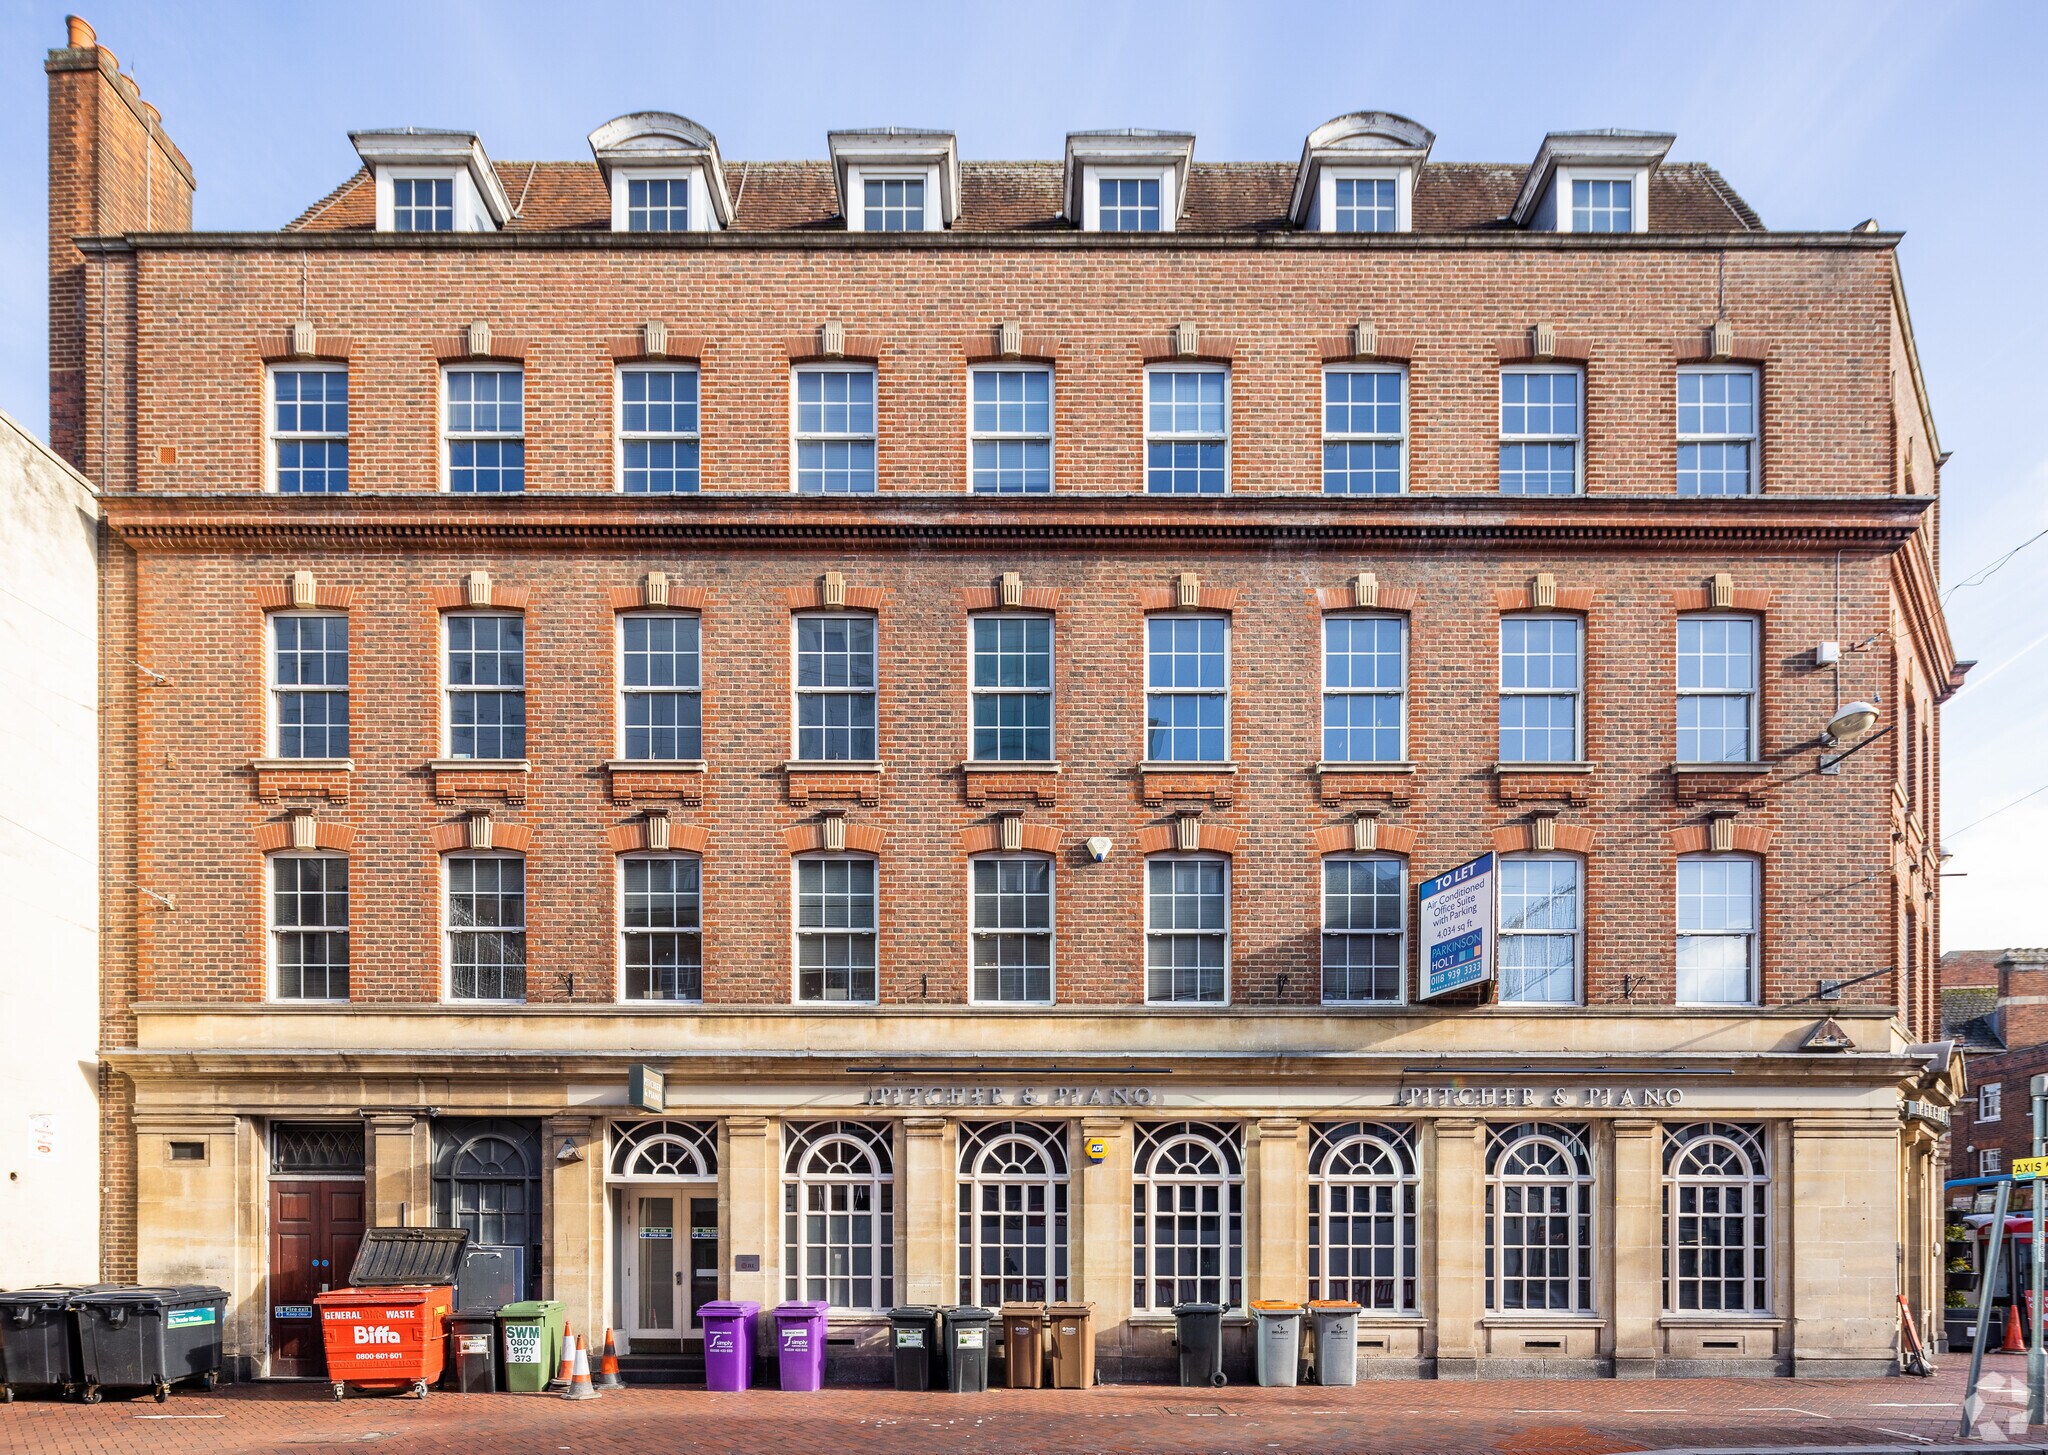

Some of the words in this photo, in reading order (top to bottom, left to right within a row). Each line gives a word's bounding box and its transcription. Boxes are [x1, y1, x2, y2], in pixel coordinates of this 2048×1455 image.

[1436, 874, 1452, 890] TO
[1454, 863, 1476, 882] LET
[1426, 901, 1437, 911] Air
[1440, 878, 1484, 905] Conditioned
[1434, 903, 1455, 917] Office
[1457, 895, 1476, 908] Suite
[1433, 914, 1448, 927] with
[1450, 904, 1477, 920] Parking
[1437, 925, 1455, 939] 4,034
[1432, 932, 1481, 958] PARKINSON
[1432, 955, 1454, 971] HOLT
[1431, 974, 1444, 985] 0118
[1448, 968, 1460, 979] 939
[1464, 962, 1480, 975] 3333
[879, 1086, 1006, 1105] PITCHER
[1024, 1086, 1040, 1105] &
[1058, 1086, 1152, 1105] PIANO
[1410, 1088, 1536, 1105] PITCHER
[1554, 1088, 1569, 1105] &
[1589, 1088, 1684, 1105] PIANO
[2013, 1162, 2041, 1173] AXIS
[324, 1311, 361, 1320] GENERAL
[386, 1310, 414, 1318] WASTE
[354, 1326, 400, 1344] Biffa
[506, 1327, 539, 1338] SWM
